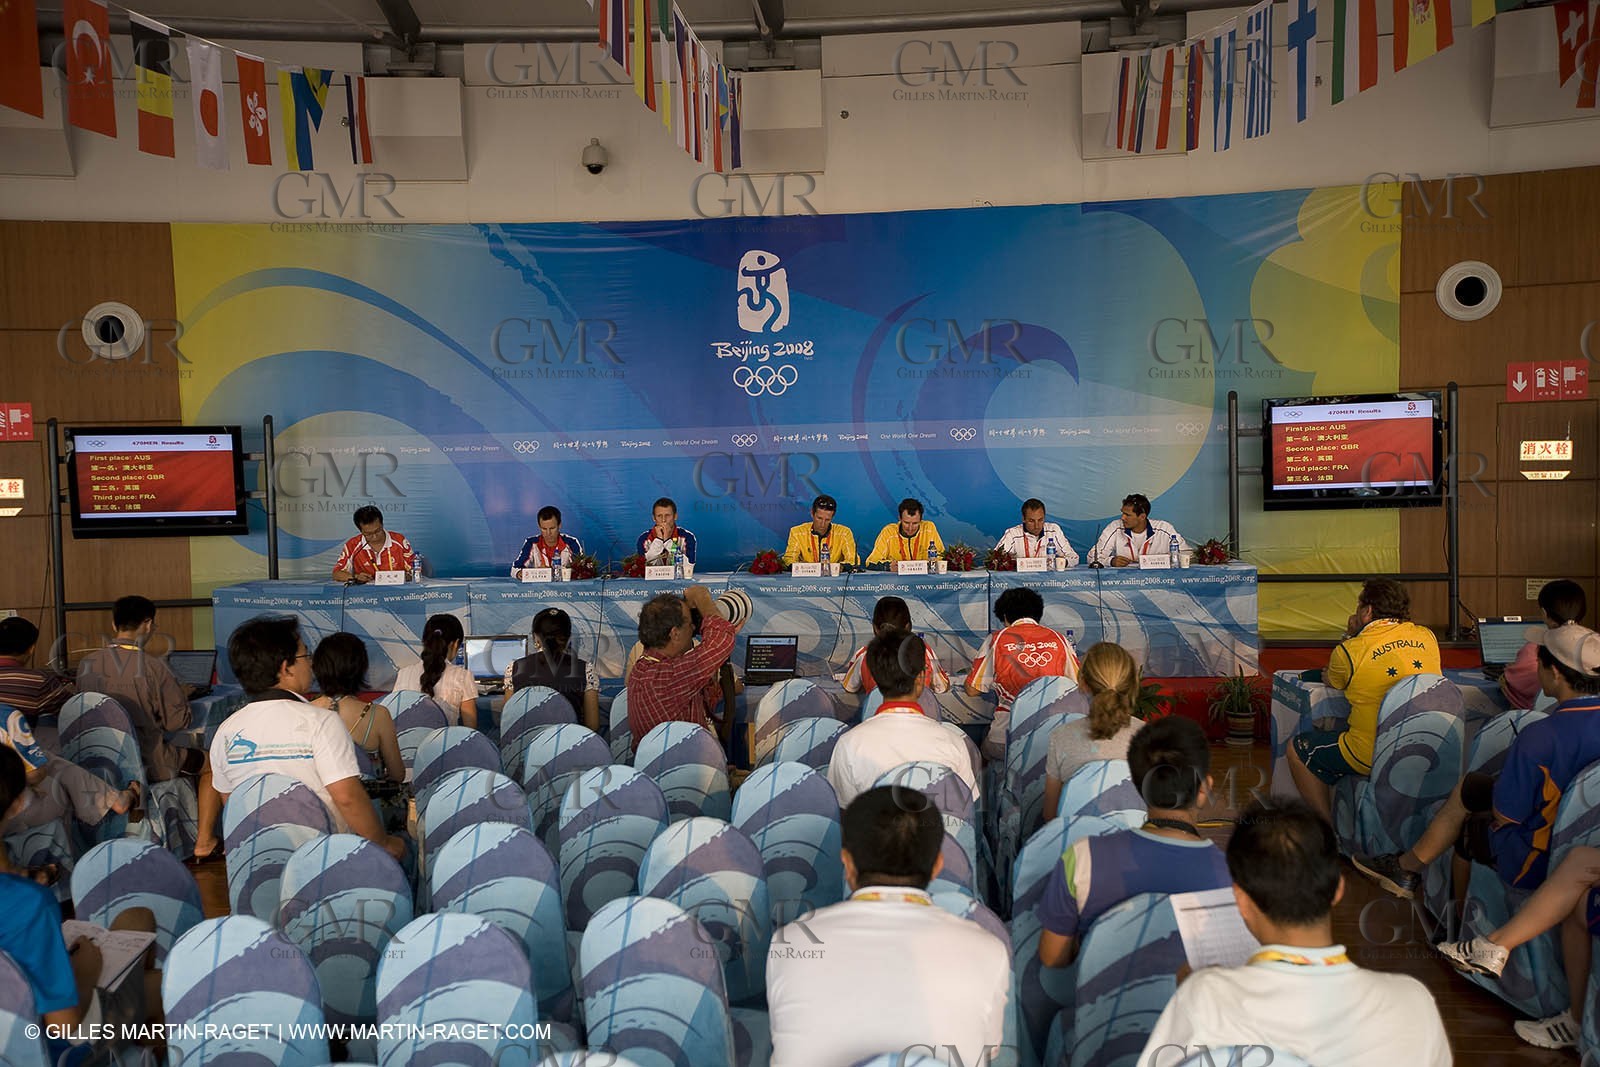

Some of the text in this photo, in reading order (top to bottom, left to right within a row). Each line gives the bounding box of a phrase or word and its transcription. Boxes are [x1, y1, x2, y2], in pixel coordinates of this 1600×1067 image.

[710, 340, 814, 362] Beijing 2008
[1305, 425, 1327, 434] place:
[1285, 445, 1313, 453] Second
[1315, 445, 1338, 453] place:
[1523, 442, 1569, 456] 消火栓
[109, 454, 132, 463] place:
[1307, 465, 1330, 473] place:
[122, 474, 145, 482] place:
[115, 494, 138, 502] place:
[1022, 579, 1096, 588] www.sailing2008.org
[1102, 577, 1175, 586] www.sailing2008.org
[1181, 574, 1255, 584] www.sailing2008.org
[759, 584, 831, 593] www.sailing2008.org
[915, 581, 987, 591] www.sailing2008.org
[383, 592, 453, 602] www.sailing2008.org
[501, 590, 573, 600] www.sailing2008.org
[233, 596, 303, 606] www.sailing2008.org
[1370, 639, 1426, 661] AUSTRALIA
